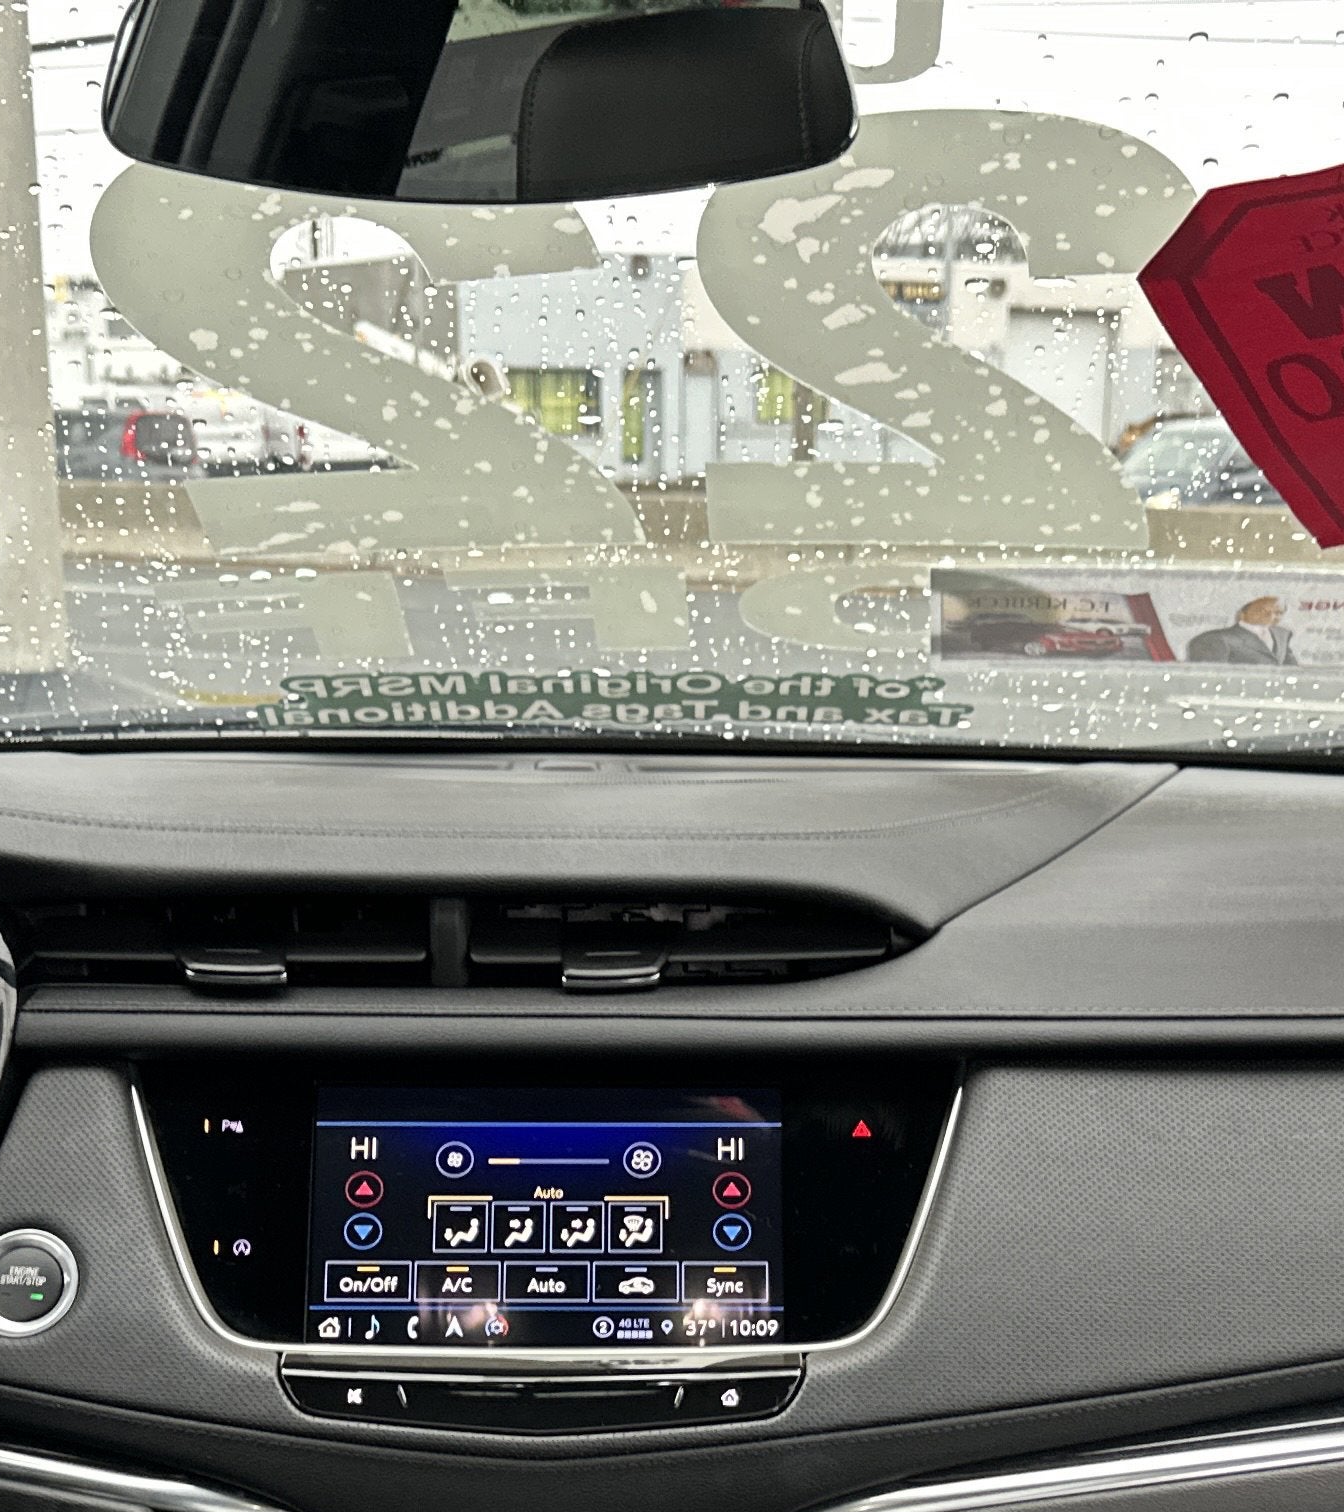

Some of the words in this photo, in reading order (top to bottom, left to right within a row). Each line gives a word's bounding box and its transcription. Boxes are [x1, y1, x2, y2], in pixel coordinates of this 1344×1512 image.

[350, 1136, 378, 1160] HI
[717, 1137, 745, 1161] HI
[534, 1185, 564, 1200] Auto
[339, 1276, 399, 1293] On/Off
[441, 1277, 473, 1293] A/C
[526, 1277, 567, 1293] Auto
[706, 1277, 744, 1297] Sync
[633, 1318, 650, 1329] LTE
[729, 1319, 779, 1337] 10:09
